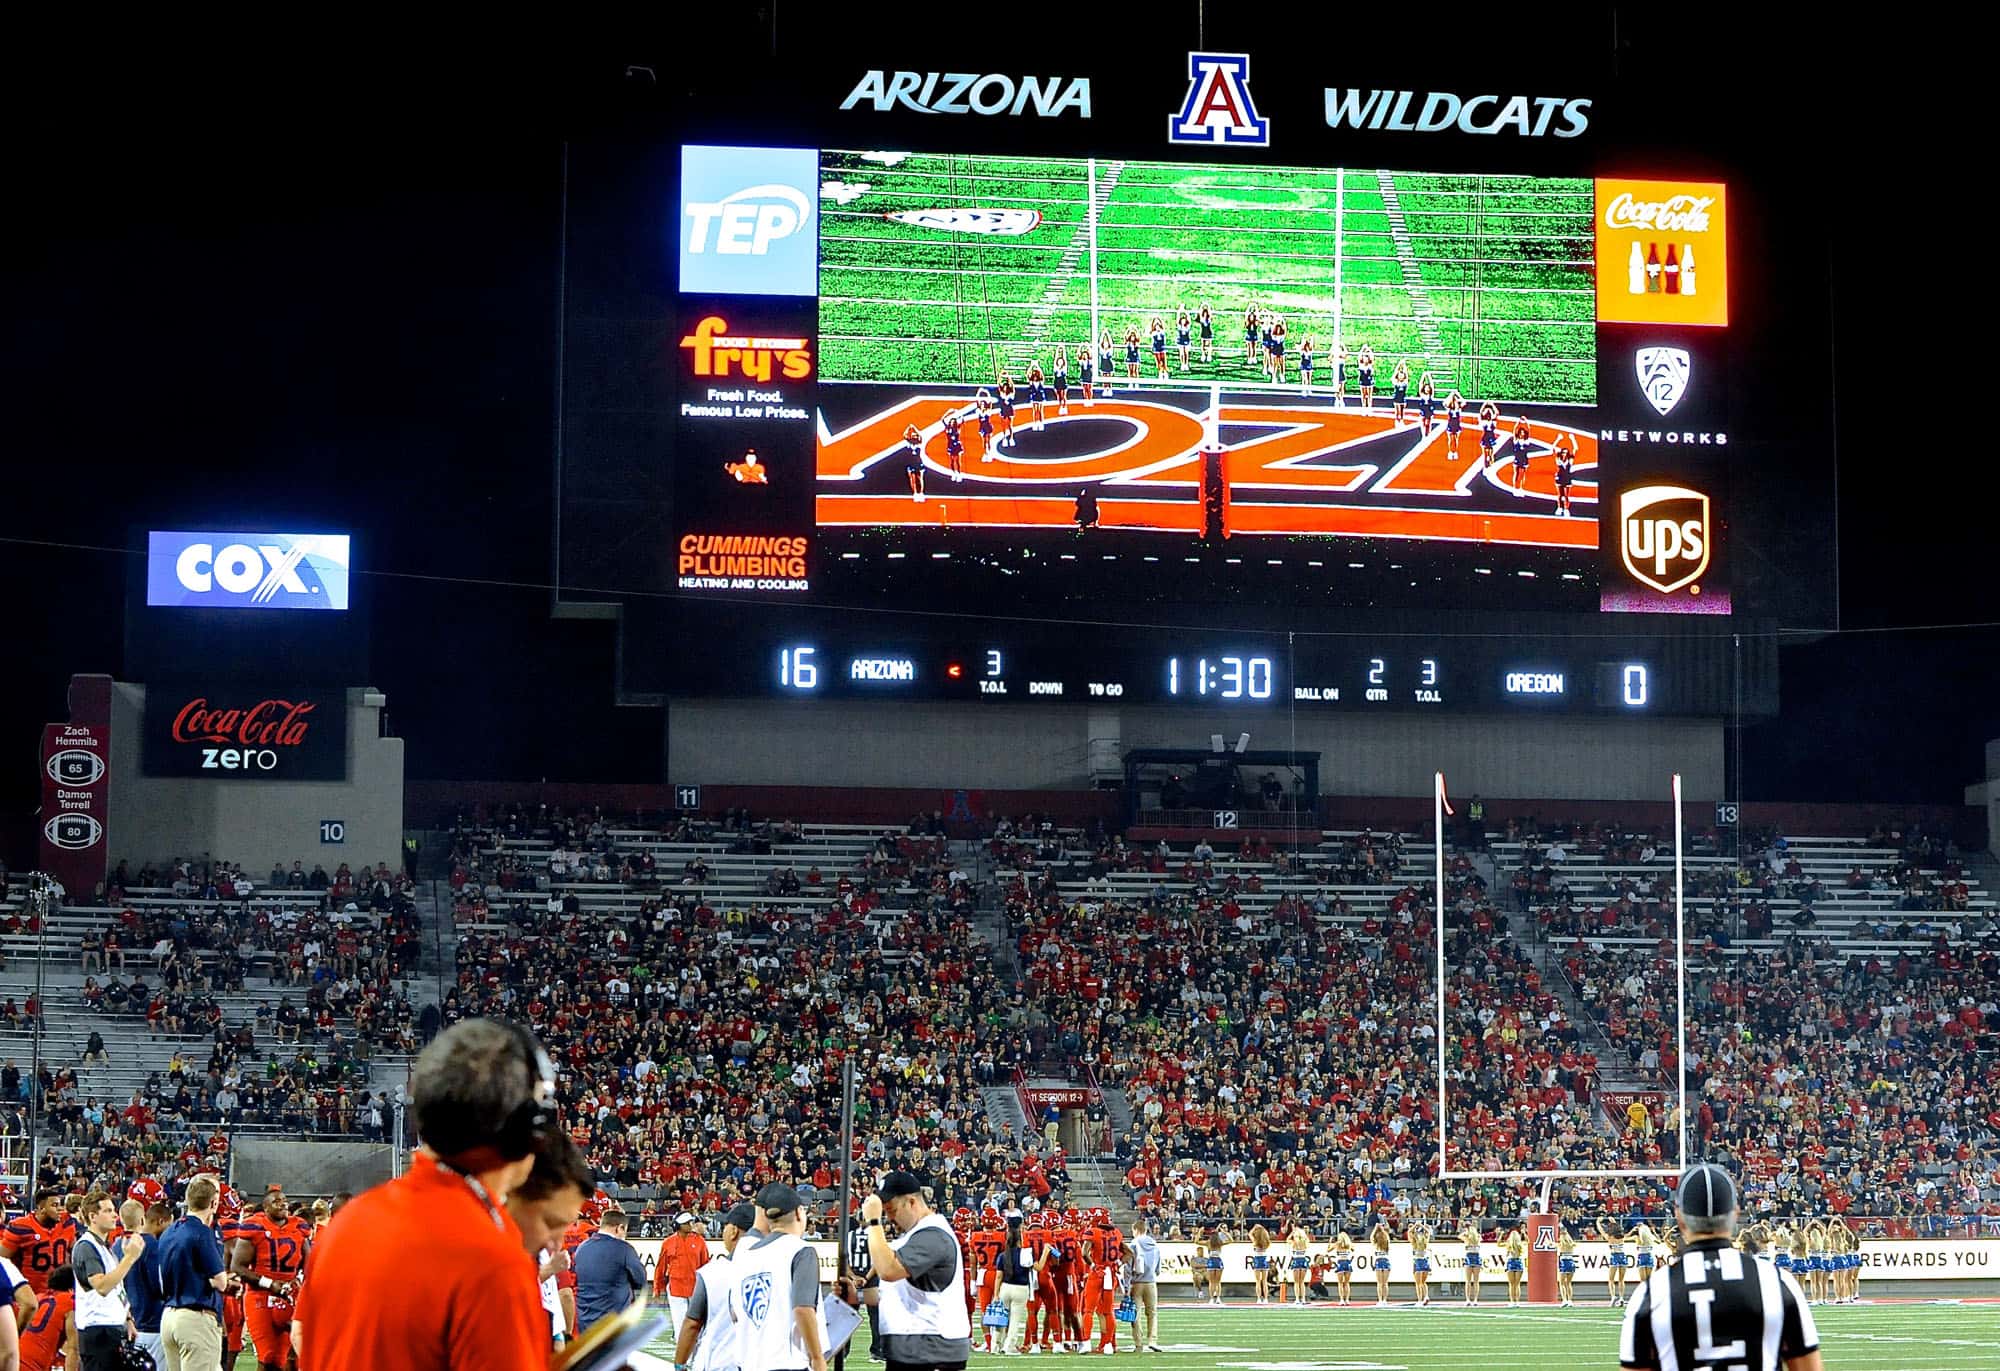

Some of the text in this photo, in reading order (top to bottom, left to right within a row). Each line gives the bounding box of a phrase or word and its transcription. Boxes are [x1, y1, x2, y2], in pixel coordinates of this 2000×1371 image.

[839, 70, 1092, 118] ARIZONA
[1168, 52, 1271, 145] A
[1324, 88, 1593, 138] WILDCATS
[685, 192, 804, 256] TEP
[680, 316, 811, 382] fry's
[707, 389, 783, 403] Fresh Food.
[1655, 383, 1673, 401] 12
[681, 404, 809, 419] Famous Low Prices.
[1601, 429, 1728, 445] NETWORKS
[680, 534, 808, 556] CUMMINGS
[1628, 519, 1703, 575] ups
[679, 555, 806, 577] PLUMBING
[679, 578, 809, 590] HEATING AND COOLING
[781, 648, 817, 689] 16
[851, 659, 914, 680] ARIZONA
[986, 650, 1001, 676] 3
[1368, 659, 1384, 684] 2
[1421, 660, 1436, 685] 3
[1169, 657, 1272, 698] 11:30
[1506, 673, 1564, 693] OREGON
[1624, 665, 1647, 705] 0
[1029, 682, 1063, 695] DOWN
[1088, 683, 1123, 696] TO GO
[1294, 687, 1339, 700] BALL ON
[1365, 689, 1388, 701] QTR
[64, 726, 90, 736] Zach
[55, 736, 98, 746] Hemmila
[68, 763, 83, 774] 65
[202, 749, 277, 769] zero
[57, 789, 92, 799] Damon
[679, 788, 697, 806] 11
[60, 800, 90, 809] Terrell
[1717, 806, 1738, 822] 13
[1215, 811, 1237, 828] 12
[67, 827, 81, 837] 80
[320, 823, 344, 840] 10
[1069, 1093, 1077, 1102] 12
[1644, 1096, 1652, 1105] 13
[855, 1235, 869, 1253] F
[1534, 1226, 1556, 1251] A
[32, 1239, 67, 1272] 60
[268, 1237, 297, 1273] 12
[974, 1241, 1003, 1266] 37
[1102, 1236, 1118, 1263] 16
[1861, 1252, 1988, 1267] REWARDS YOU
[1688, 1288, 1747, 1361] L
